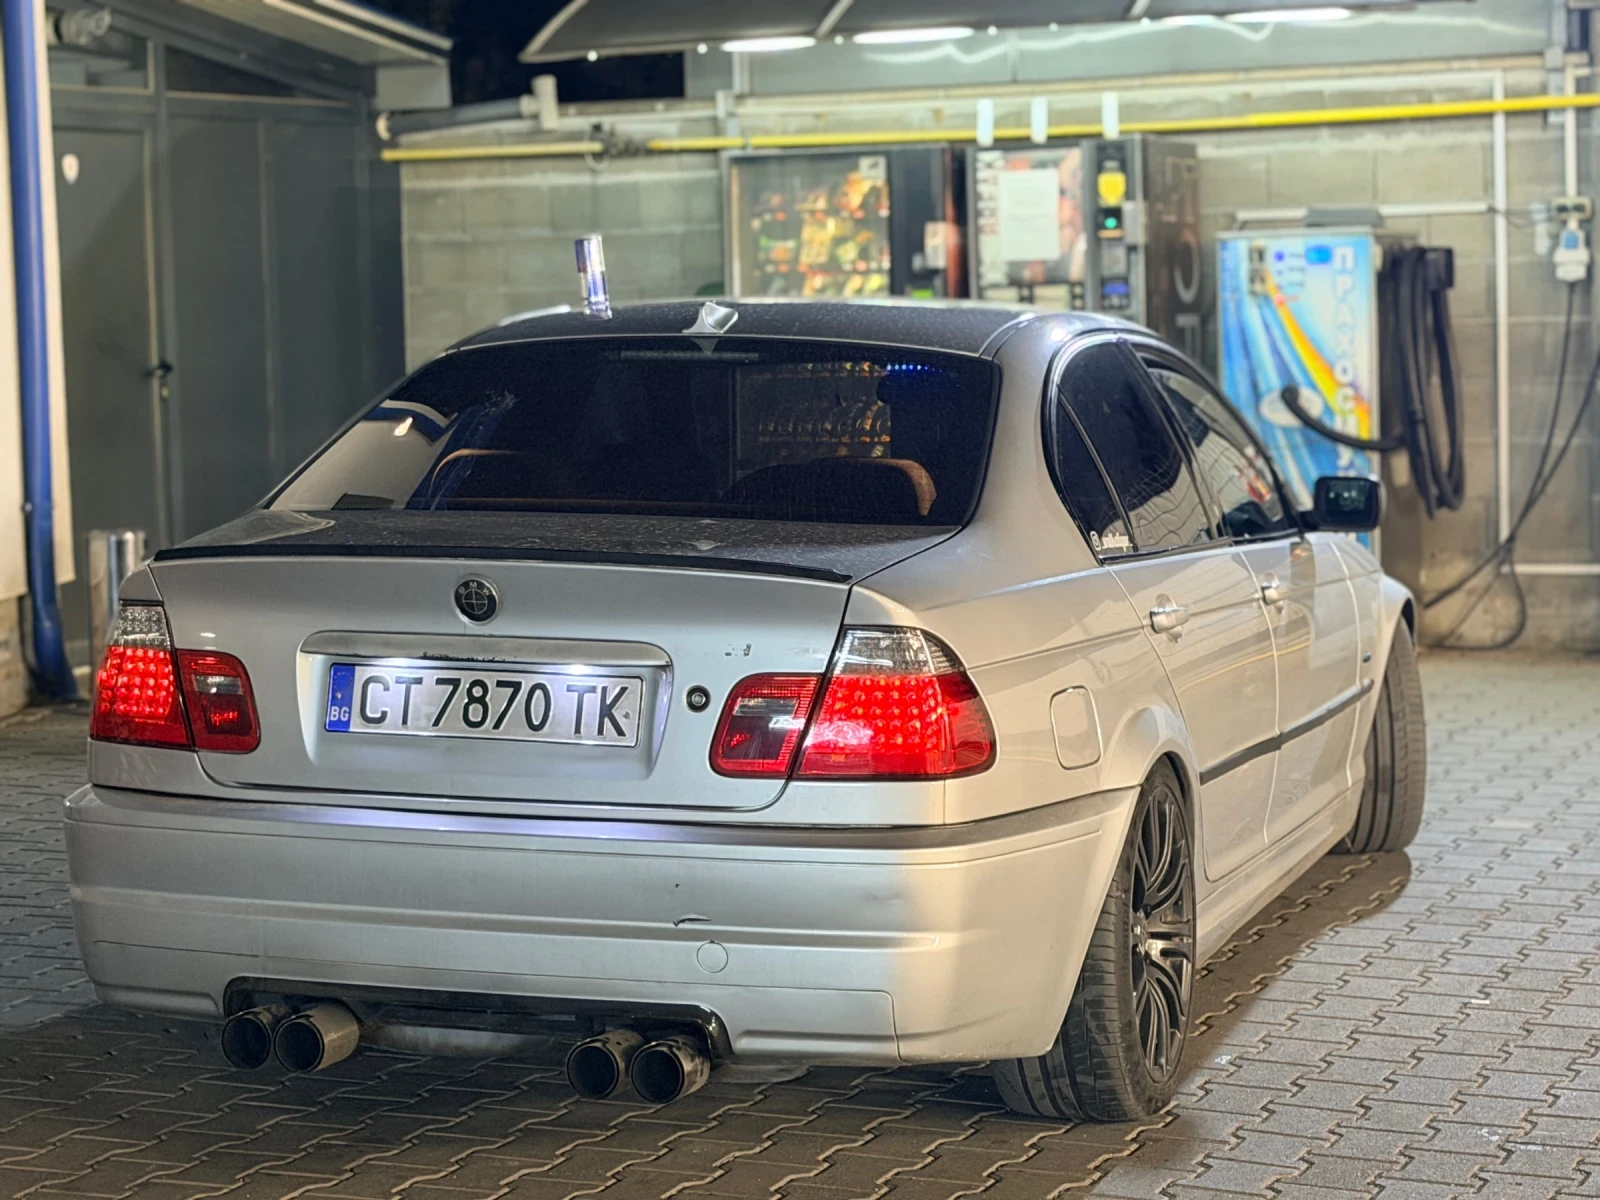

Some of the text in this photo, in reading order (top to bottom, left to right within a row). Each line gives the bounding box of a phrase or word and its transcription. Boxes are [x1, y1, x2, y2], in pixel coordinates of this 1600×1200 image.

[458, 581, 490, 596] BMW
[330, 706, 350, 722] BG
[360, 675, 629, 737] CT 7870 TK
